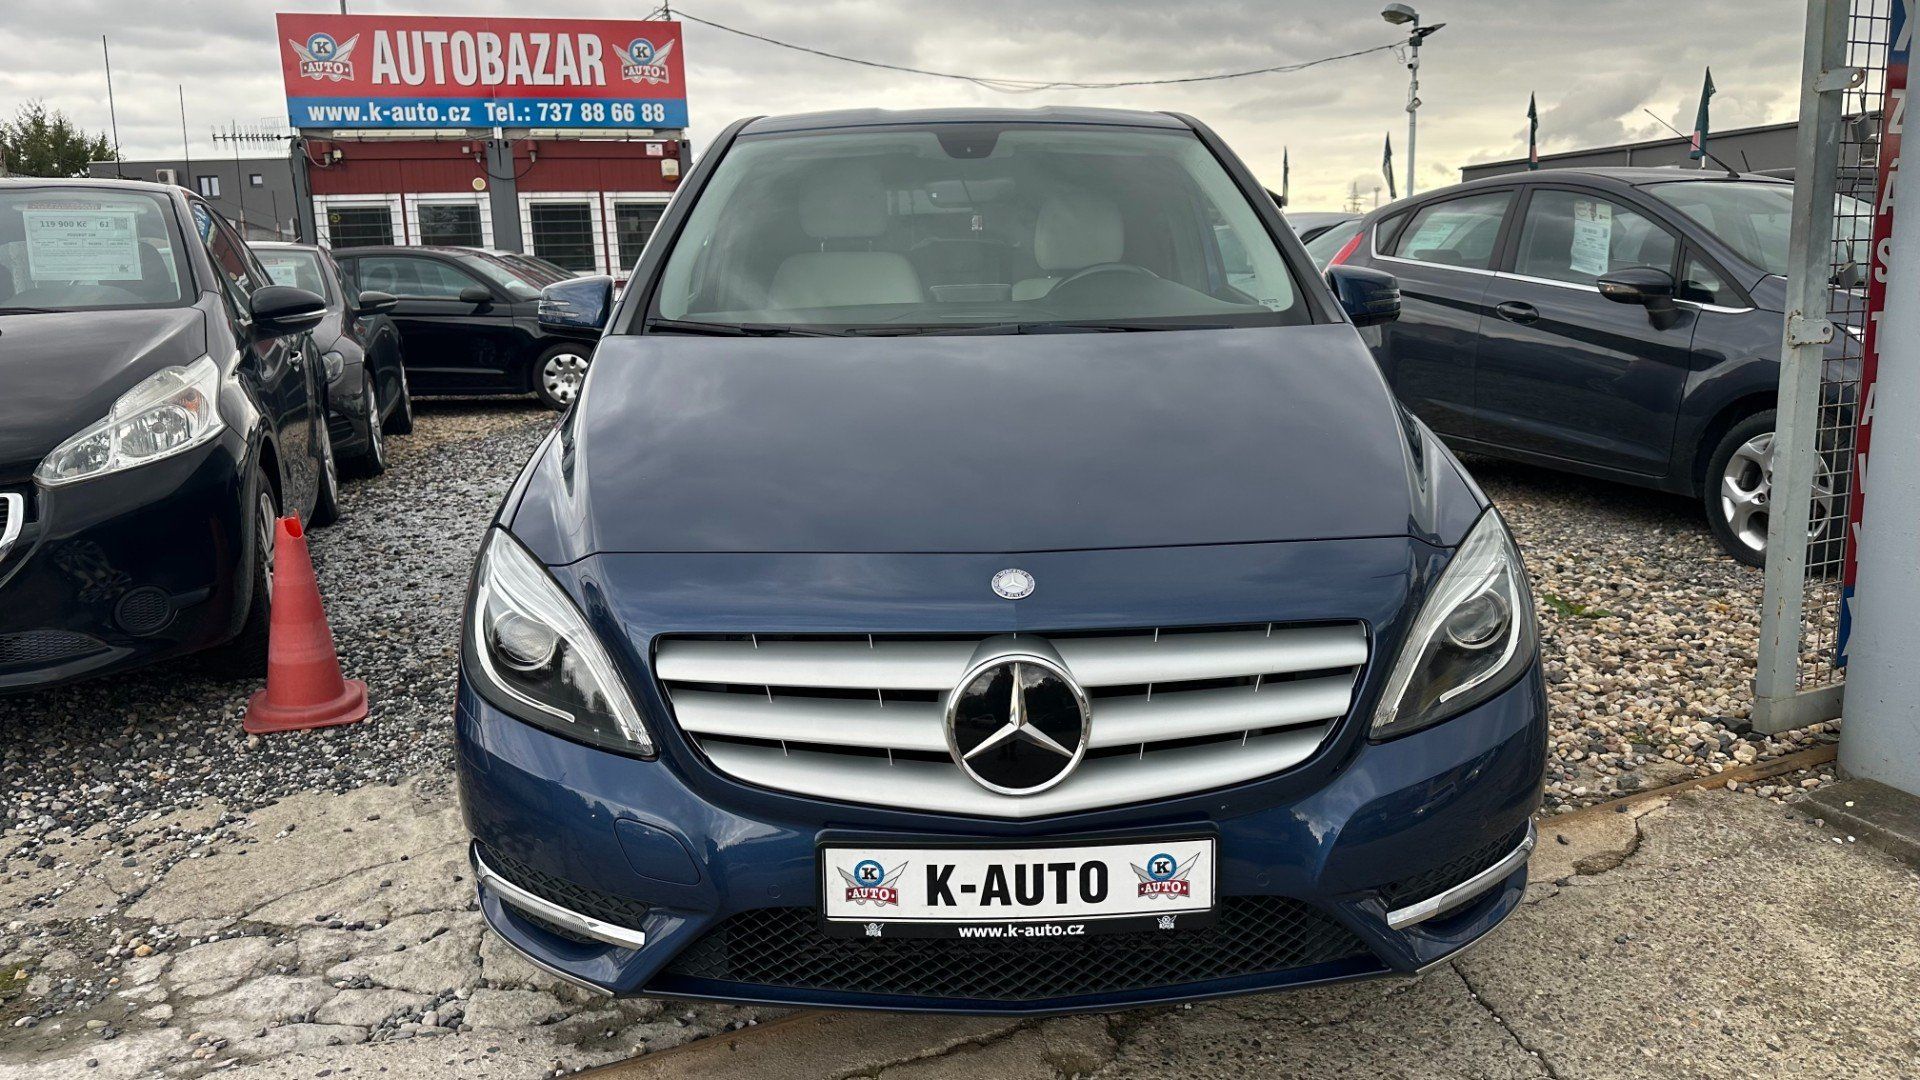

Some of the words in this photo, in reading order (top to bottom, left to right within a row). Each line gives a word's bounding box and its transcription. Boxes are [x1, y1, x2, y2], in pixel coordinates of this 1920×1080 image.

[314, 41, 330, 54] K
[635, 46, 649, 58] K
[371, 29, 607, 87] AUTOBAZAR
[307, 61, 344, 74] AUTO
[627, 65, 660, 77] AUTO
[307, 102, 471, 122] www.k-auto.cz
[484, 102, 531, 122] Tel.:
[537, 102, 573, 122] 737
[580, 102, 605, 122] 88
[610, 102, 635, 122] 66
[641, 103, 665, 122] 88
[40, 220, 56, 228] 119
[58, 220, 75, 228] 900
[99, 220, 109, 228] 61
[861, 867, 877, 880] K
[1154, 861, 1170, 874] K
[926, 860, 1109, 907] K-AUTO
[1144, 881, 1182, 893] AUTO
[852, 888, 890, 901] AUTO
[958, 923, 1085, 938] www.k-auto.cz
